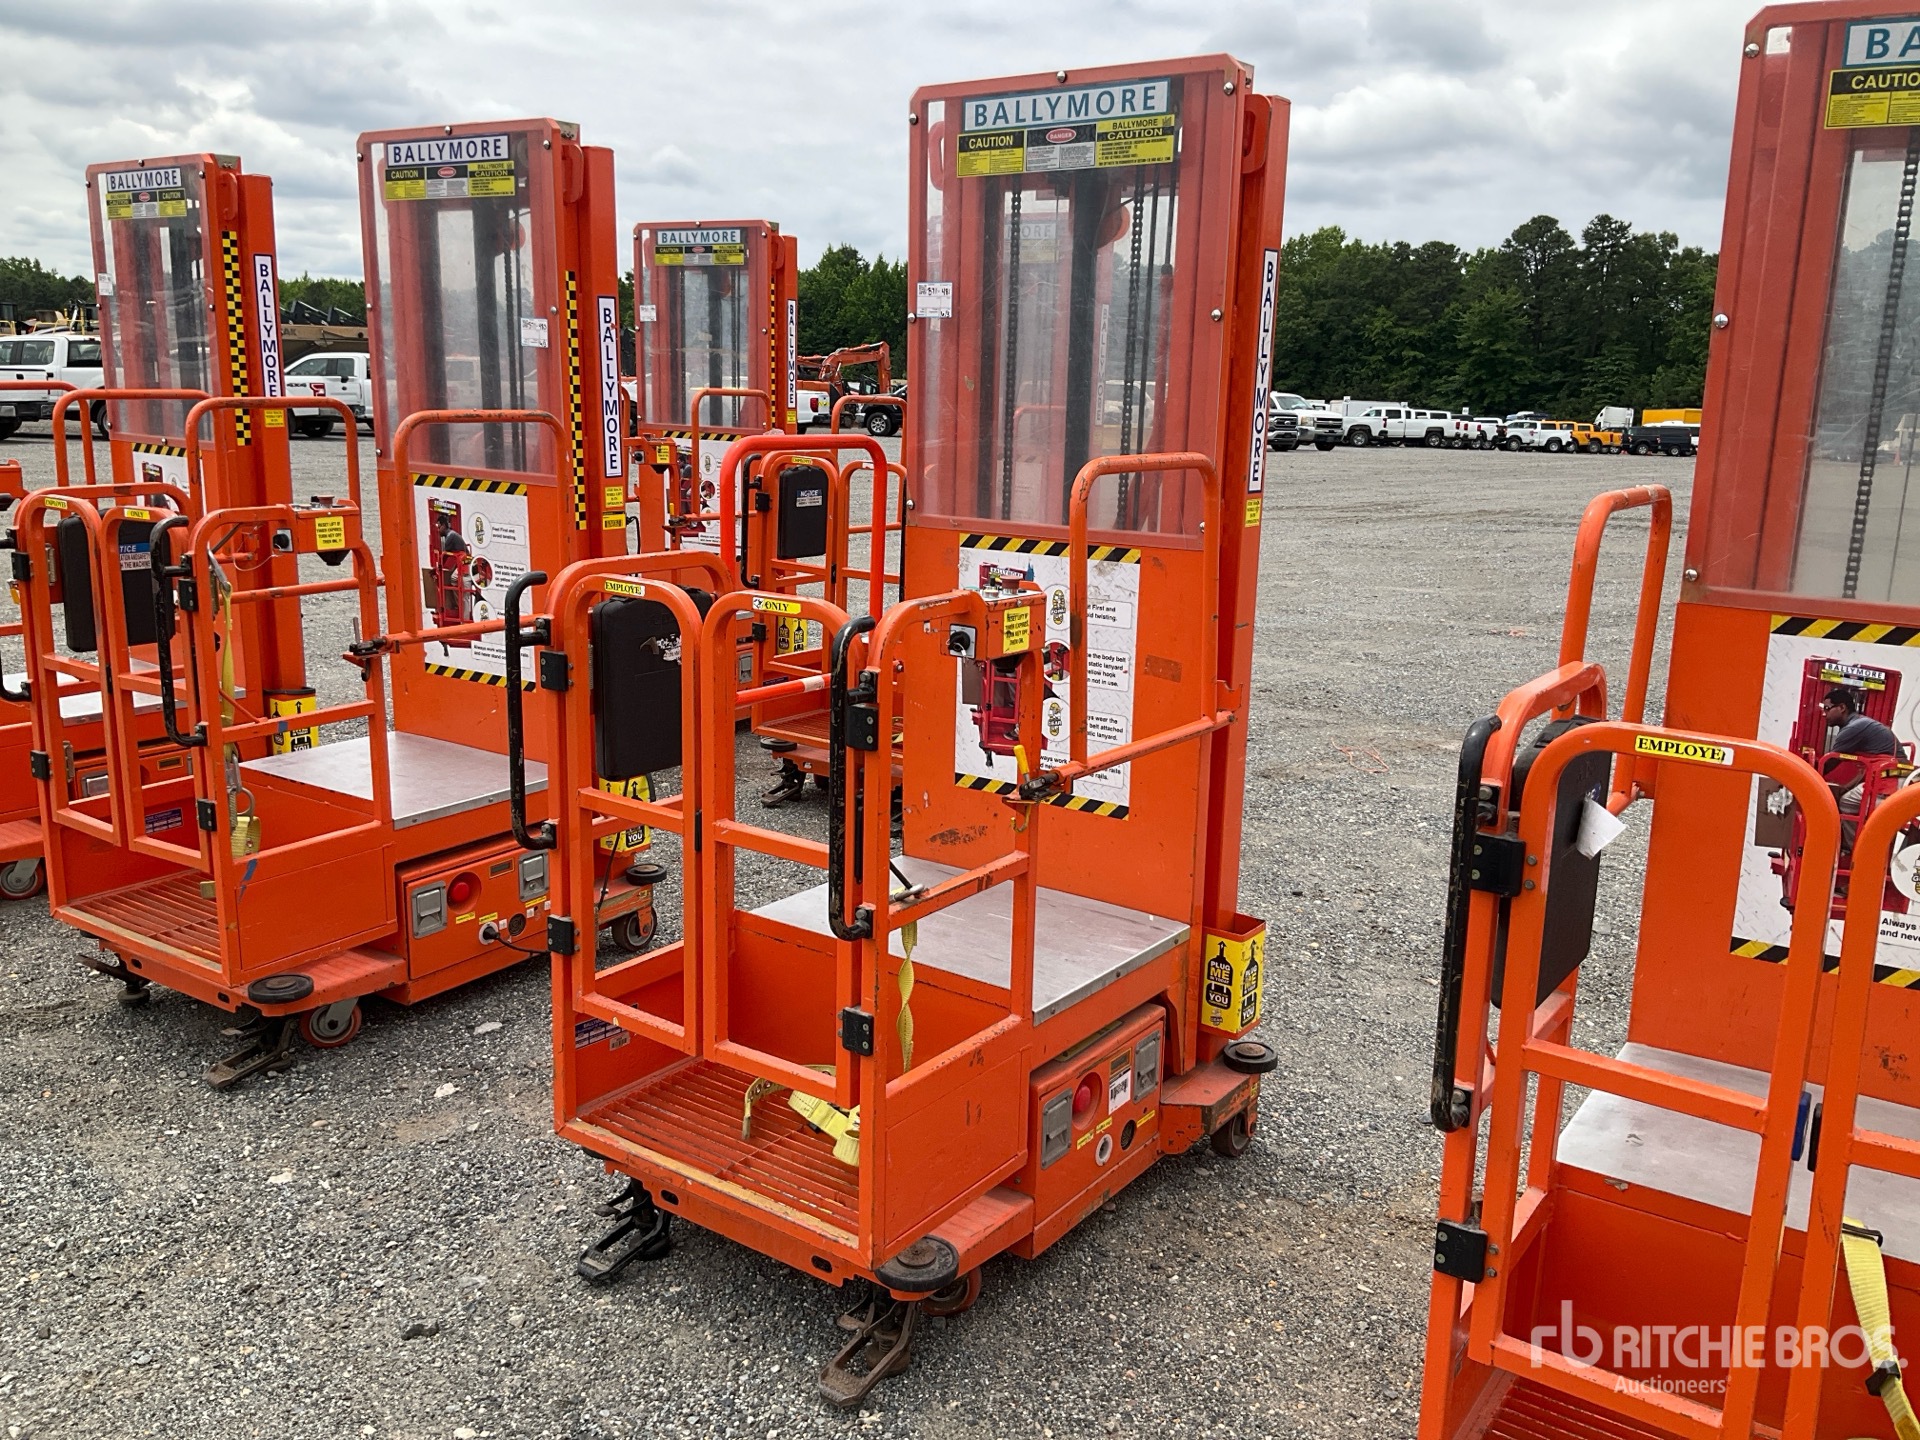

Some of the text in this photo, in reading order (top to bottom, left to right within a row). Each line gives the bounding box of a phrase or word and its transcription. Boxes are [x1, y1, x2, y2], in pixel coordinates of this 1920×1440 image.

[974, 86, 1156, 127] BALLYMORE
[1112, 118, 1159, 130] BALLYMORE
[1107, 128, 1163, 140] CAUTION
[969, 134, 1013, 149] CAUTION
[393, 138, 501, 163] BALLYMORE
[110, 170, 178, 190] BALLYMORE
[391, 169, 418, 179] CAUTION
[661, 231, 736, 244] BALLYMORE
[259, 263, 277, 397] BALLYMORE
[1252, 260, 1274, 482] BALLYMORE
[603, 307, 619, 470] BALLYMORE
[130, 510, 144, 518] ONLY
[119, 544, 137, 552] TICE
[764, 600, 789, 612] ONLY
[1092, 603, 1105, 612] First
[1106, 605, 1116, 613] and
[1095, 612, 1117, 622] twisting.
[1092, 652, 1127, 663] the body belt
[1088, 669, 1116, 679] ellow hook
[1103, 663, 1124, 673] lanyard
[1827, 663, 1882, 679] BALLYMORE
[1100, 724, 1124, 733] attached
[1096, 731, 1118, 741] lanyard.
[1040, 755, 1053, 763] ways
[628, 831, 643, 843] YOU
[1881, 917, 1917, 931] Always
[1879, 929, 1898, 938] and
[1210, 960, 1231, 971] PLUG
[1209, 967, 1230, 981] ME
[1209, 992, 1229, 1005] YOU
[1242, 1006, 1255, 1019] YOU
